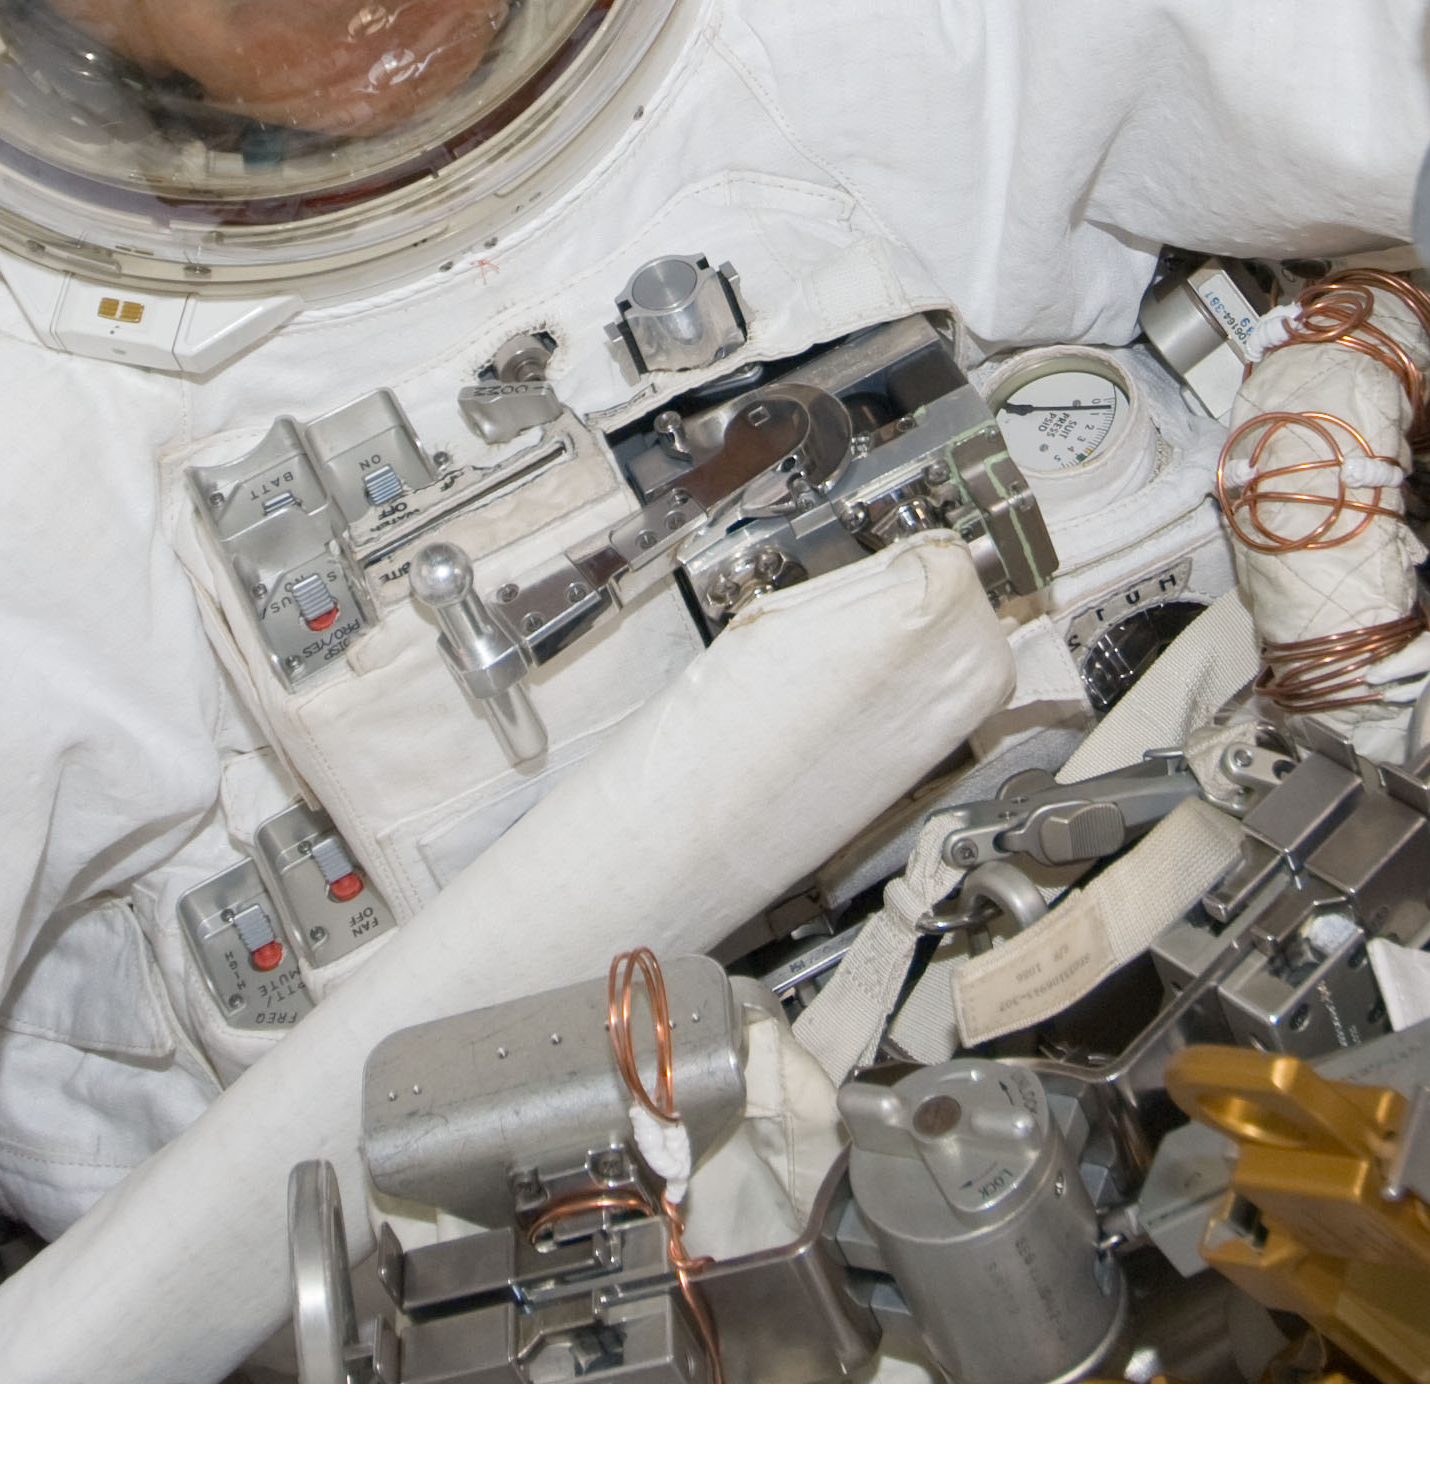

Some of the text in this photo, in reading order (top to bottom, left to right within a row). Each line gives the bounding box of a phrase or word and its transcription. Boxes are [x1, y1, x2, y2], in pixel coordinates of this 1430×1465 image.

[1038, 412, 1057, 432] PSID
[1046, 412, 1070, 438] PRESS
[1059, 420, 1077, 440] SUIT
[358, 454, 382, 471] ON
[250, 471, 294, 501] BATT
[378, 502, 408, 520] OFF
[302, 619, 360, 659] PRO/YES
[349, 907, 374, 927] OFF
[352, 917, 379, 938] FAN
[258, 967, 301, 997] MUTE
[256, 1012, 298, 1024] FREQ
[979, 1168, 1014, 1199] LOCK
